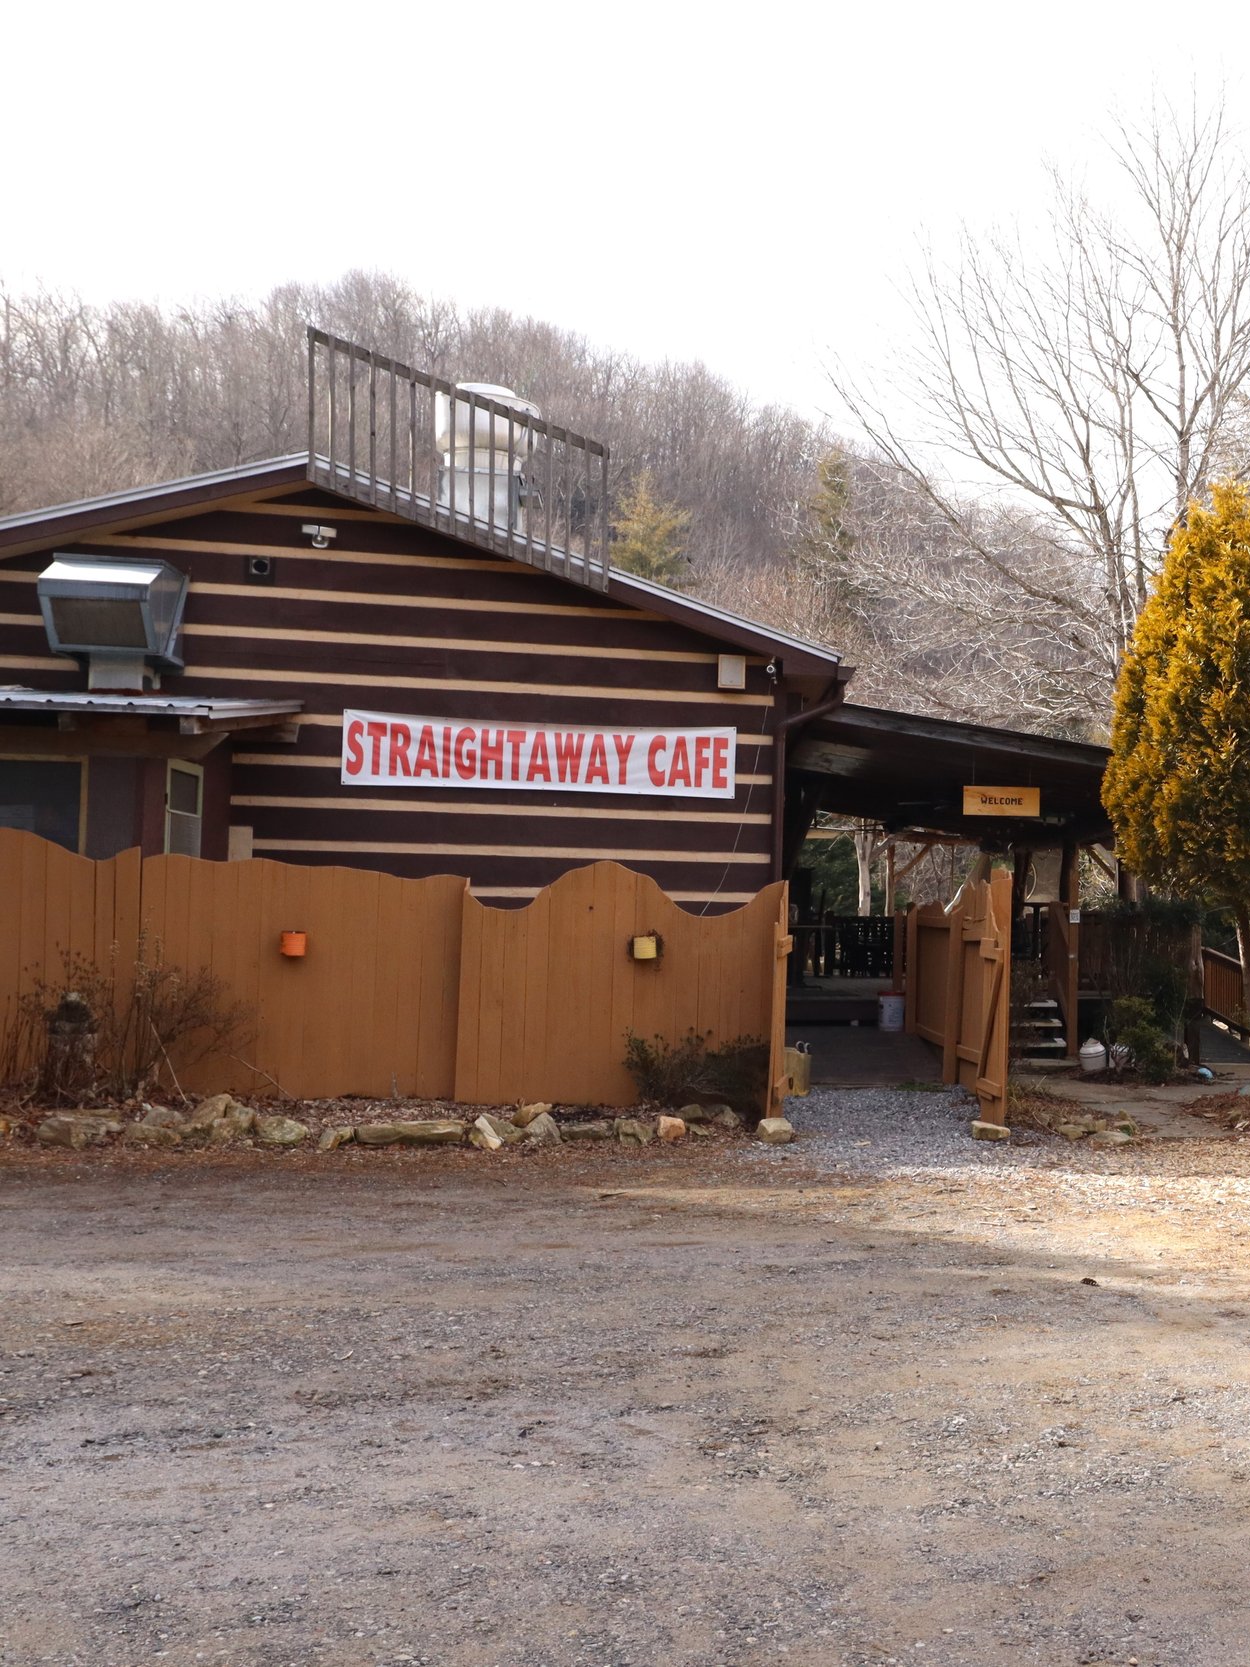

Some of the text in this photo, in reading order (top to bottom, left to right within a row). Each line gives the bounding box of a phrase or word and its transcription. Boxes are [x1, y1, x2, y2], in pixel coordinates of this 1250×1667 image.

[346, 720, 729, 788] STRAIGHTAWAY CAFE
[980, 796, 1023, 806] WELCOME
